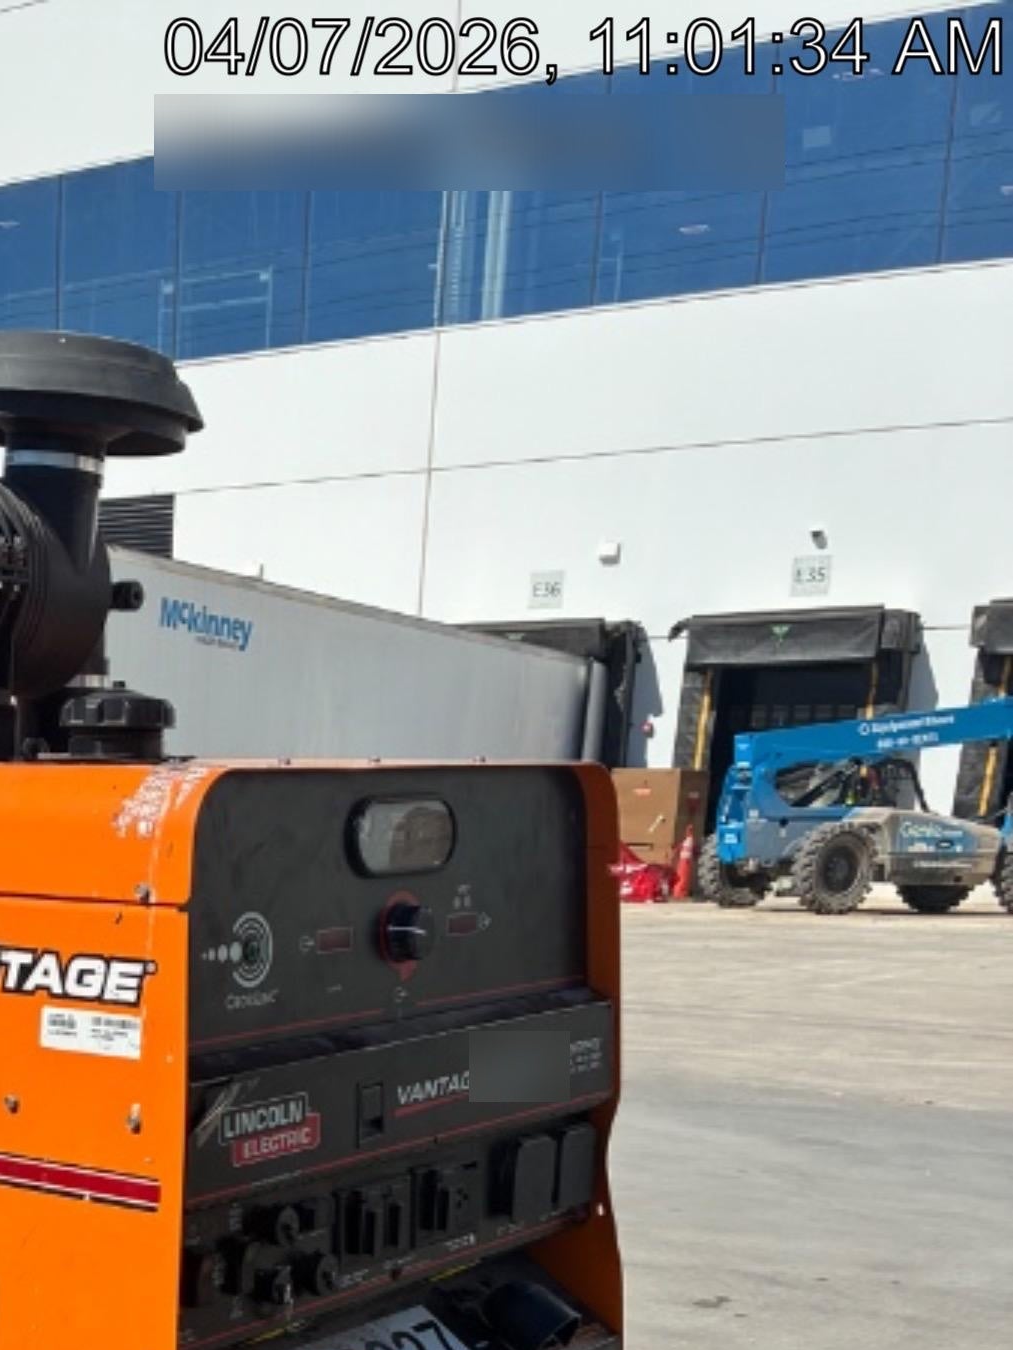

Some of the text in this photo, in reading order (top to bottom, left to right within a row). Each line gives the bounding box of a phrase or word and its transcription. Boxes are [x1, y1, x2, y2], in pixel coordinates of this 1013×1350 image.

[397, 1070, 470, 1105] VANTAG
[223, 1099, 303, 1138] LINCOLN
[243, 1127, 312, 1159] ELECTRIC
